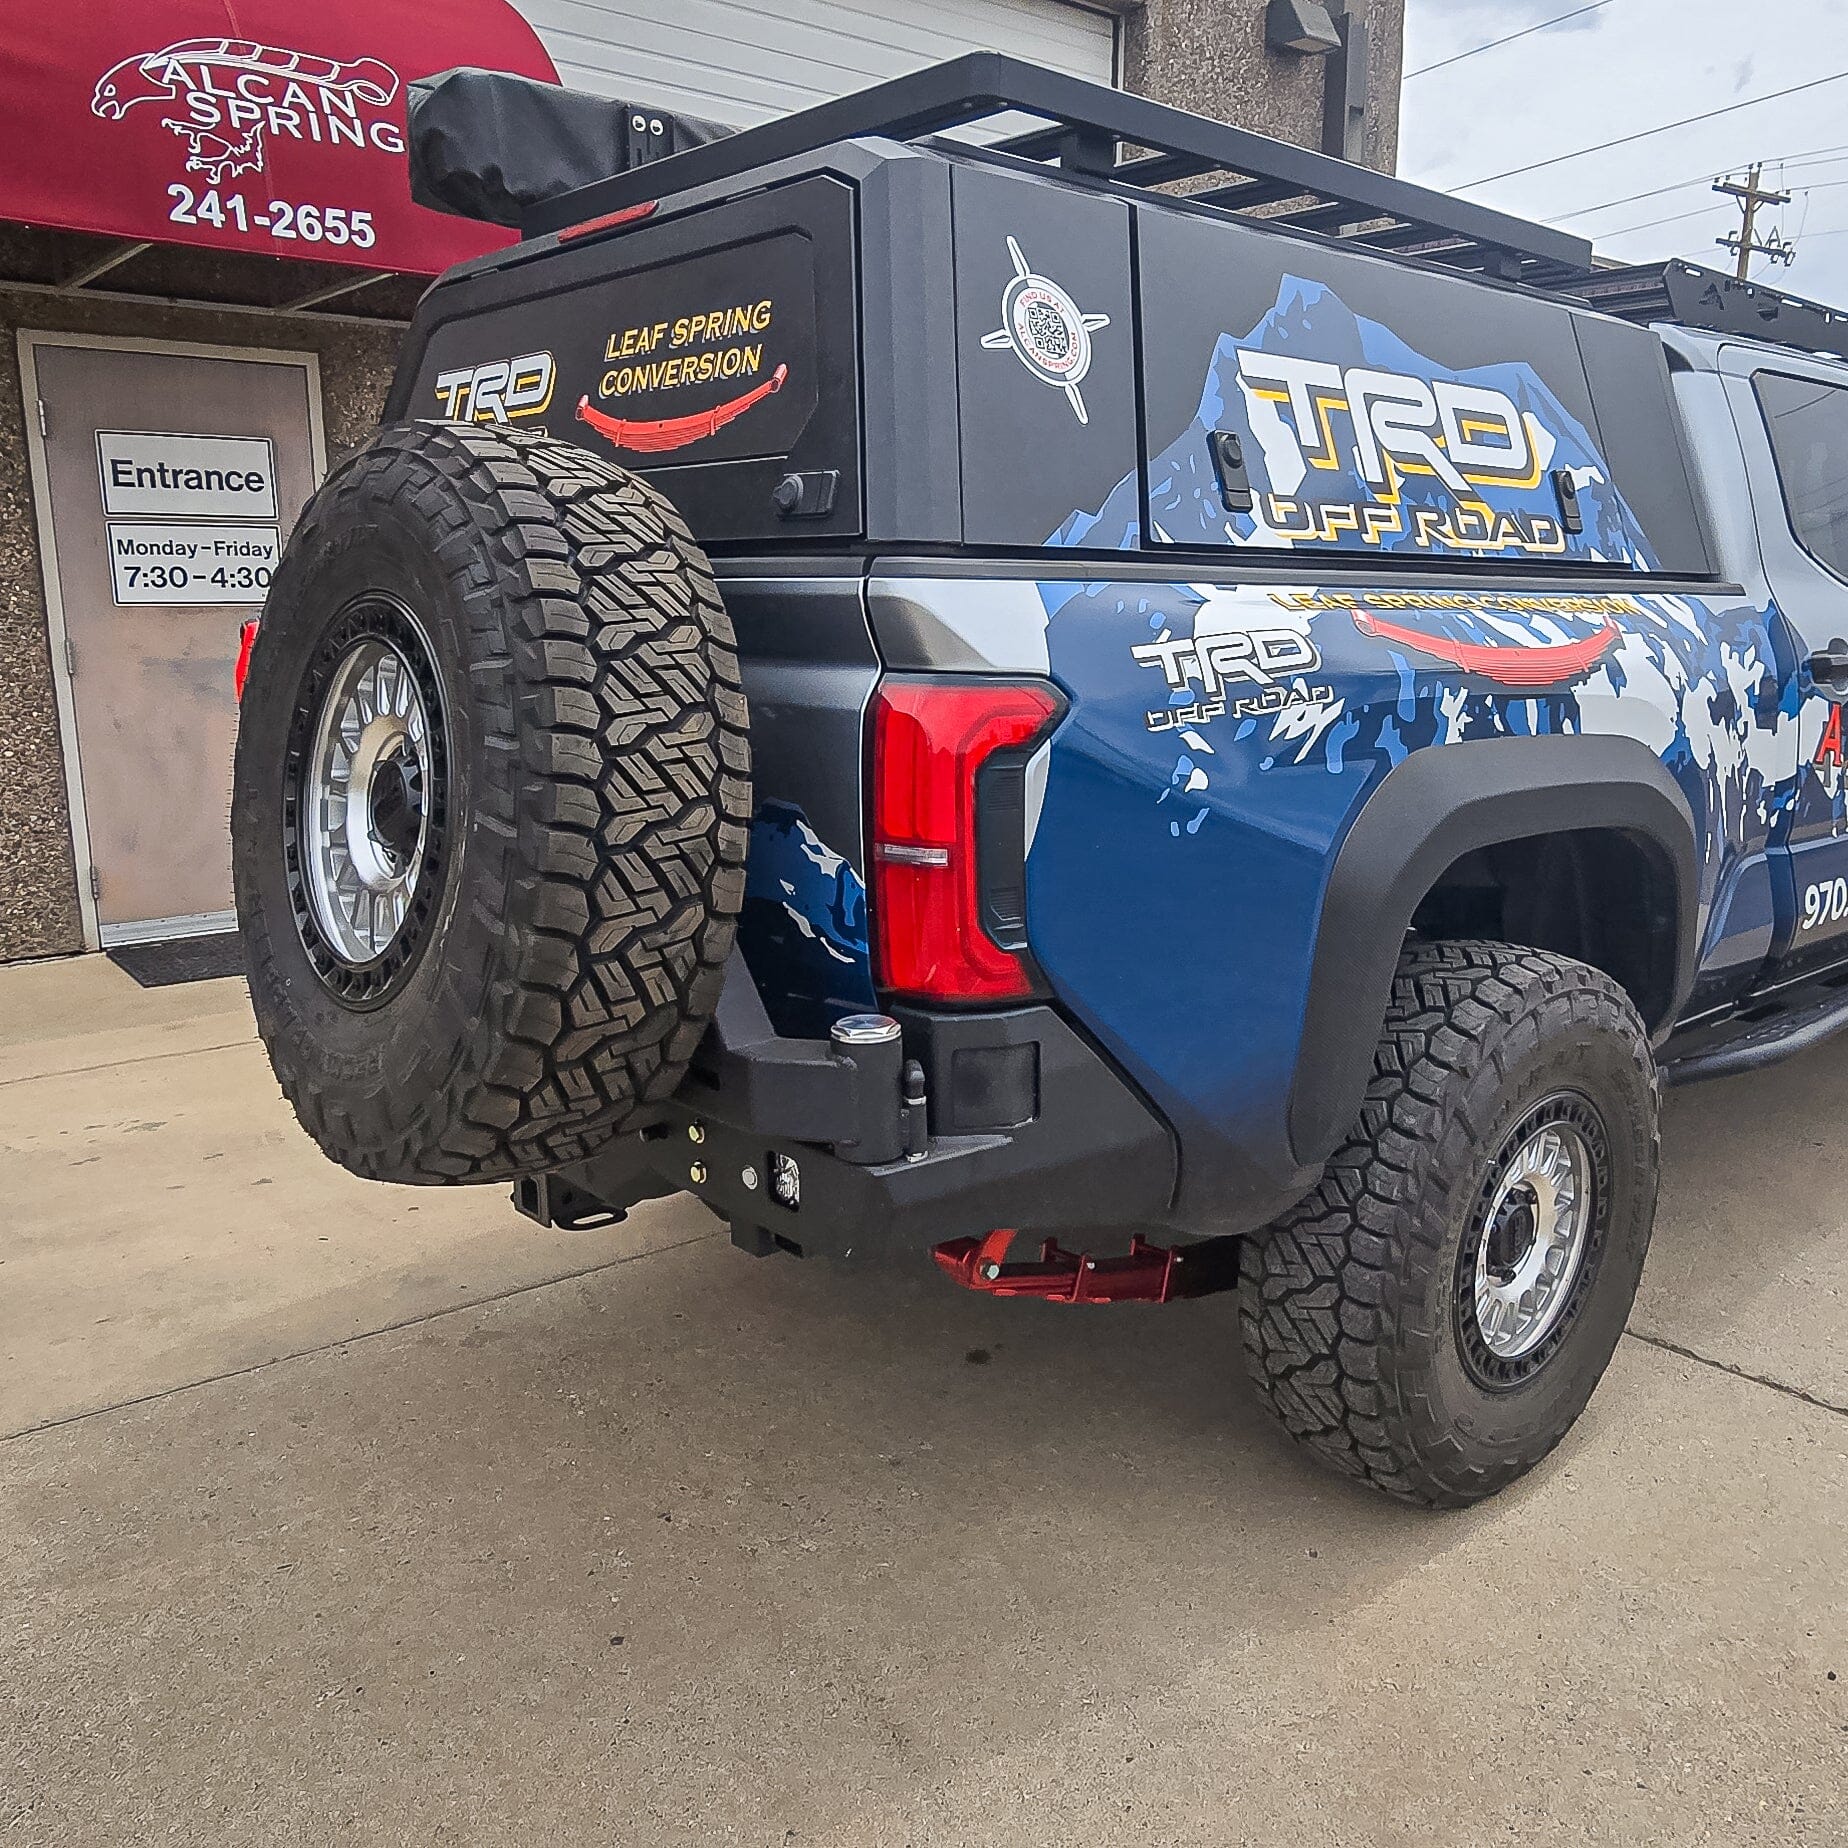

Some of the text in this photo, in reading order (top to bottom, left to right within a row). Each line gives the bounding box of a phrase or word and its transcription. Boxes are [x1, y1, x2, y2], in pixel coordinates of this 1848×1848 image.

[162, 59, 357, 118] ALCAN
[185, 92, 406, 153] SPRING
[167, 183, 377, 248] 241-2655
[603, 300, 774, 362] LEAF SPRING
[435, 350, 557, 424] TRD
[599, 343, 765, 399] CONVERSION
[1236, 348, 1541, 504] TRD
[110, 458, 265, 493] Entrance
[1261, 493, 1566, 553] OFF ROAD
[1267, 593, 1643, 615] LEAF SPRING CONVERSION
[1130, 629, 1322, 700] TRD
[1145, 684, 1335, 732] OFF ROAD
